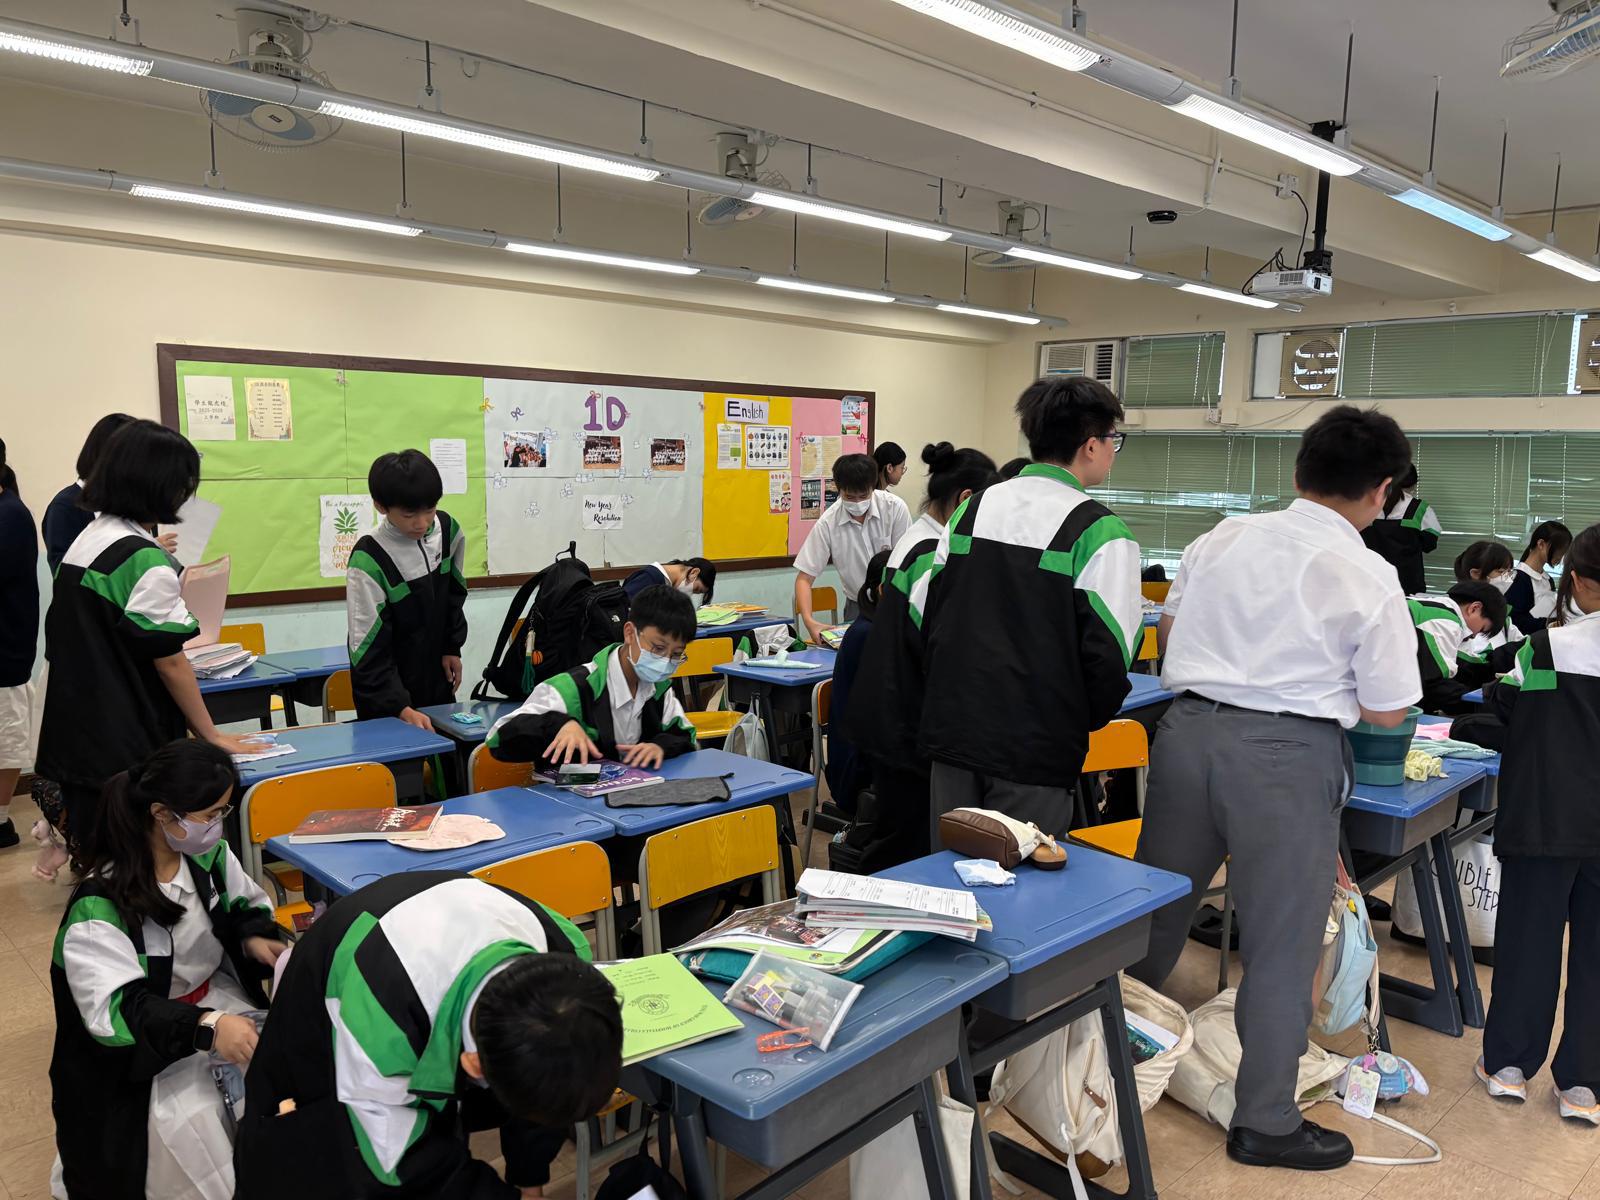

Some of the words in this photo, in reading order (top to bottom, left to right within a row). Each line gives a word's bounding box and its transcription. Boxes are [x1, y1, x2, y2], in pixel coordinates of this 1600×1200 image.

[583, 394, 627, 431] 1D
[727, 400, 764, 419] English
[584, 499, 596, 509] New
[598, 500, 612, 512] Year
[593, 513, 621, 524] Resolution
